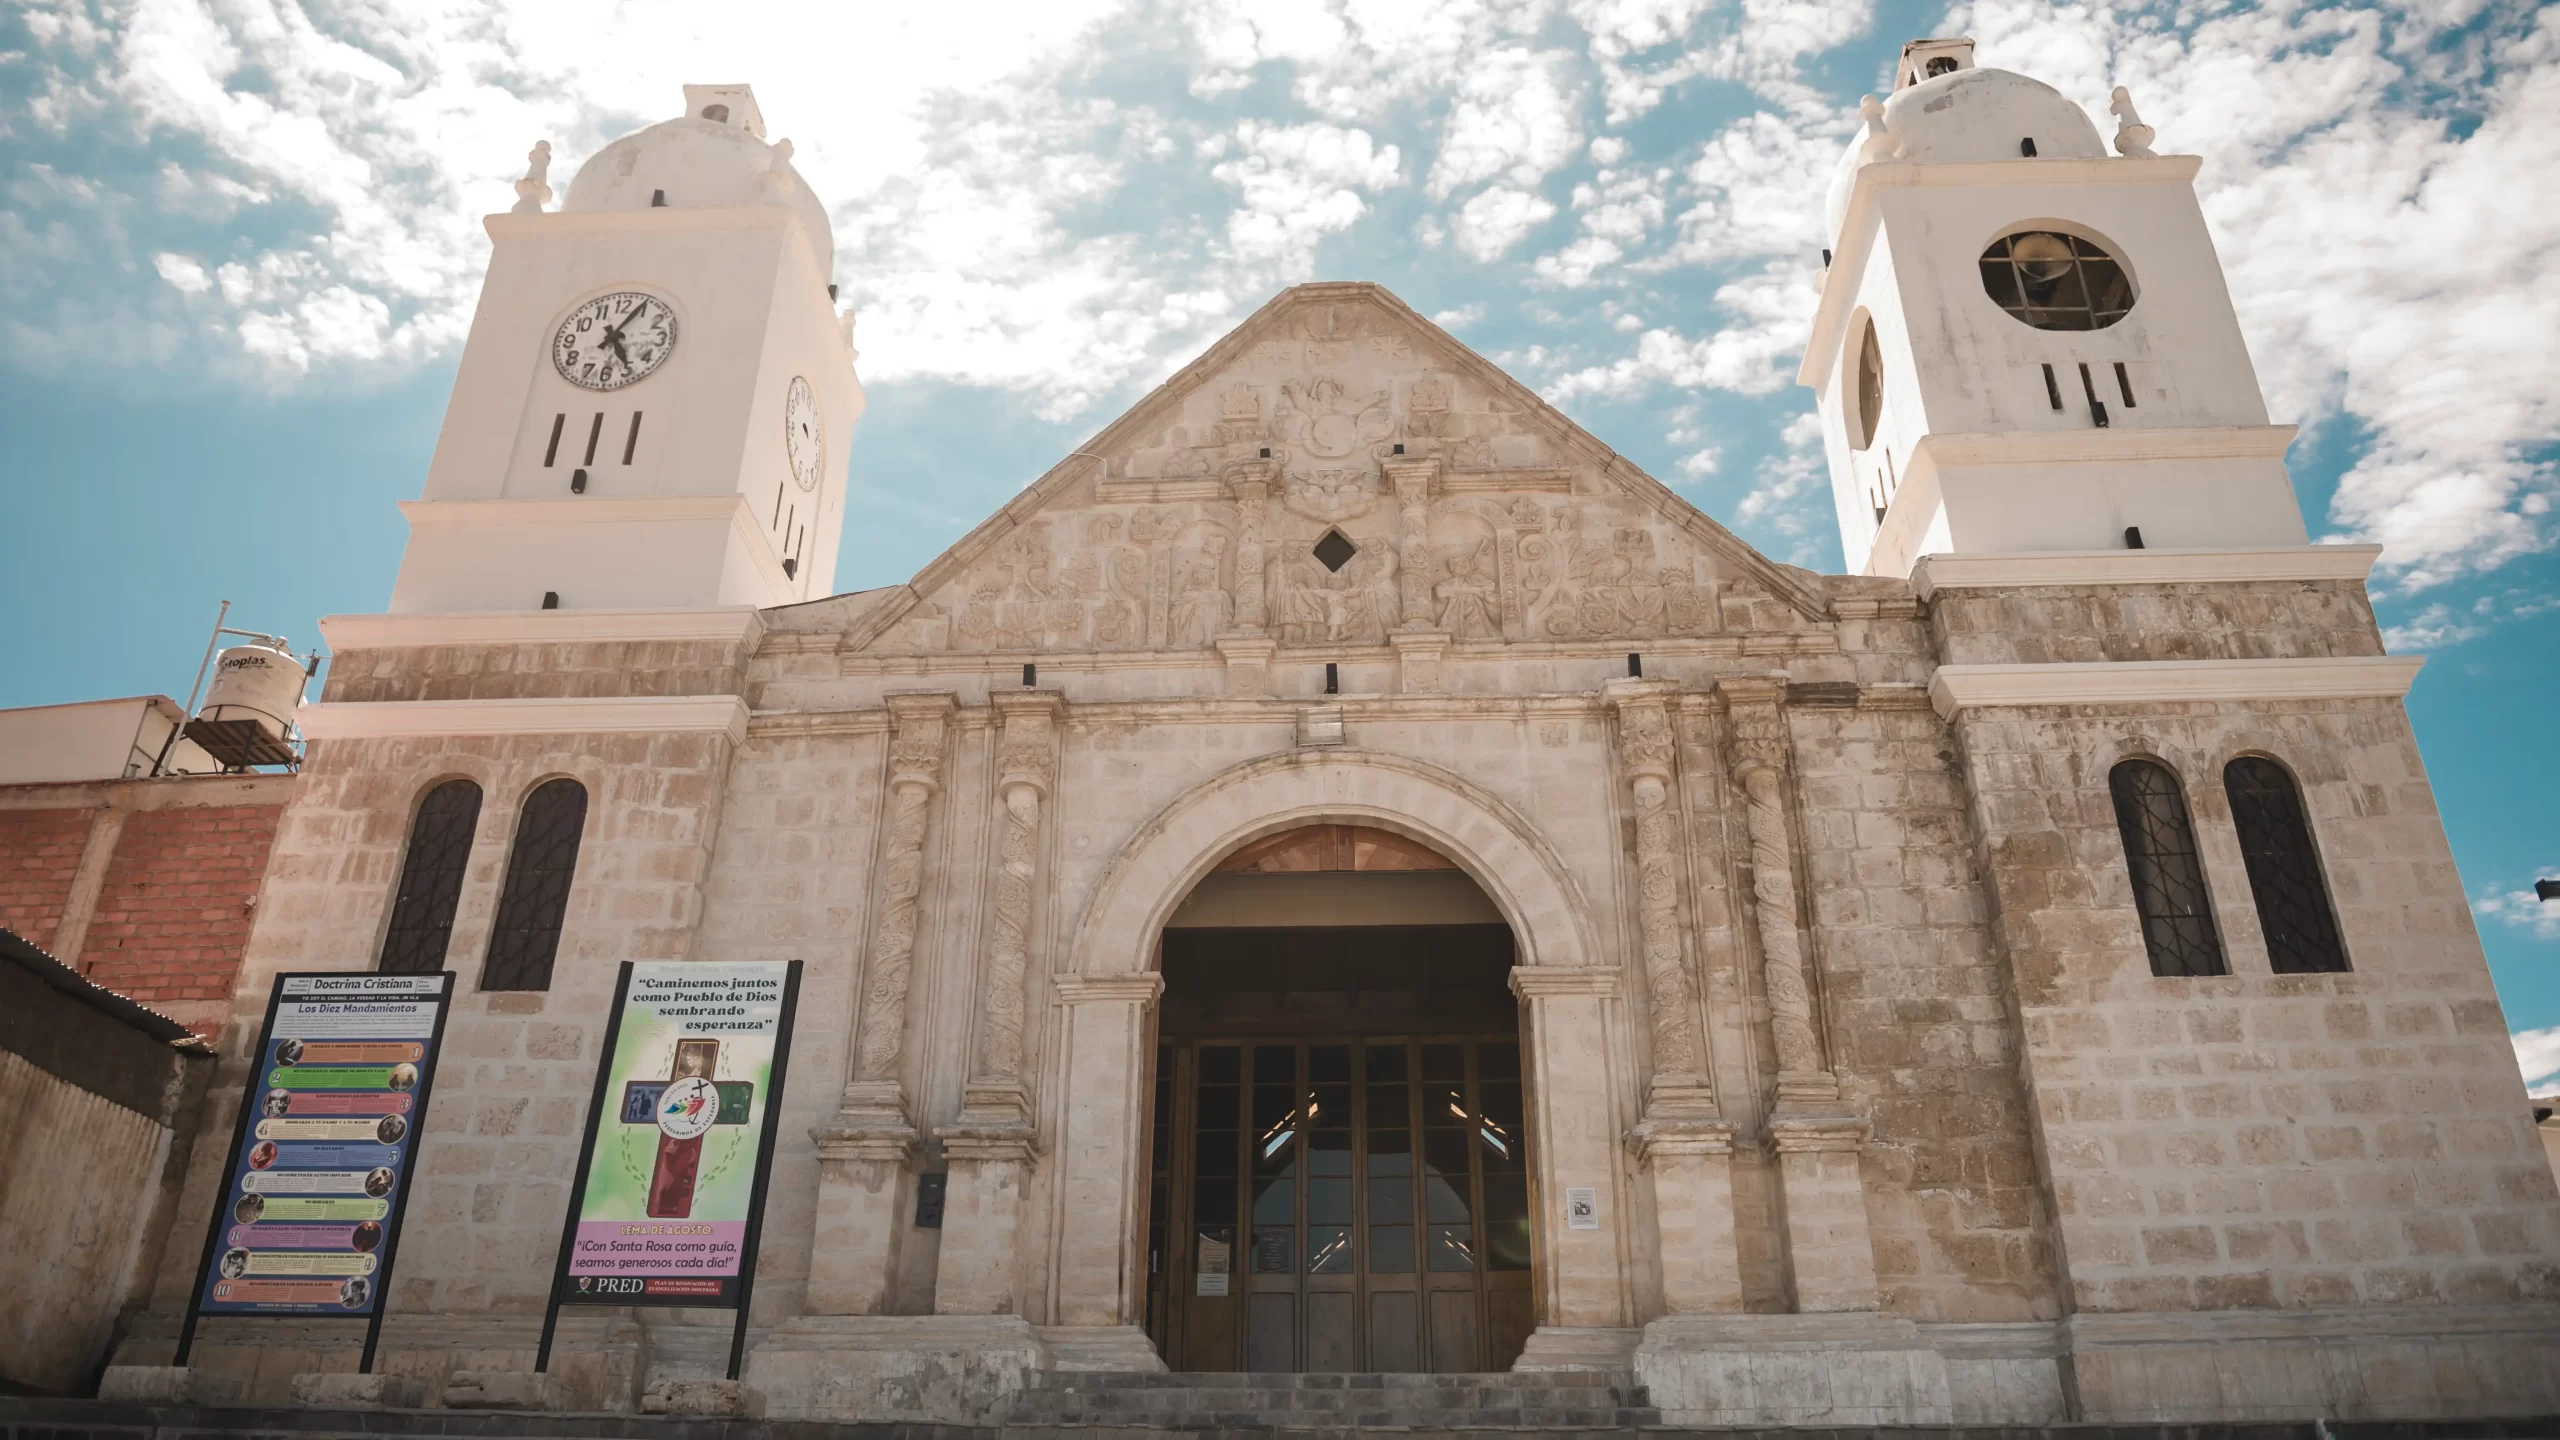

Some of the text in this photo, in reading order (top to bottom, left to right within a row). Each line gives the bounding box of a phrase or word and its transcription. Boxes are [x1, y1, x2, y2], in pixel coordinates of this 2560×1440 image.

[595, 304, 609, 320] 11
[615, 299, 633, 314] 12
[640, 301, 648, 318] 1
[576, 317, 593, 333] 10
[650, 313, 664, 330] 2
[562, 334, 576, 349] 9
[653, 331, 668, 347] 3
[565, 350, 580, 366] 8
[640, 348, 654, 364] 4
[583, 363, 596, 378] 7
[600, 366, 613, 382] 6
[620, 360, 634, 377] 5
[222, 656, 266, 670] toplas
[314, 978, 413, 989] Doctrina Cristiana
[729, 978, 778, 990] juntos
[633, 991, 777, 1002] como Pueblo de Dios
[298, 1003, 417, 1013] Los Diez Mandamientos
[658, 1006, 745, 1016] sembrando
[413, 1047, 419, 1058] 1
[271, 1072, 281, 1083] 2
[400, 1098, 410, 1109] 3
[663, 1121, 693, 1136] PEREGRINOS
[703, 1095, 716, 1127] ESPERANZA
[257, 1123, 268, 1136] 4
[388, 1150, 398, 1162] 5
[244, 1175, 255, 1188] 6
[377, 1204, 386, 1216] 7
[230, 1230, 241, 1242] 8
[620, 1225, 714, 1235] LEMA DE AGOSTO:
[610, 1240, 643, 1252] Santa
[645, 1240, 672, 1252] Rosa
[675, 1243, 706, 1252] como
[709, 1241, 737, 1254] guía,
[364, 1258, 375, 1271] 9
[575, 1258, 616, 1268] seamos
[618, 1258, 672, 1270] generosos
[675, 1257, 704, 1268] cada
[215, 1284, 232, 1297] 10
[596, 1278, 644, 1293] PRED
